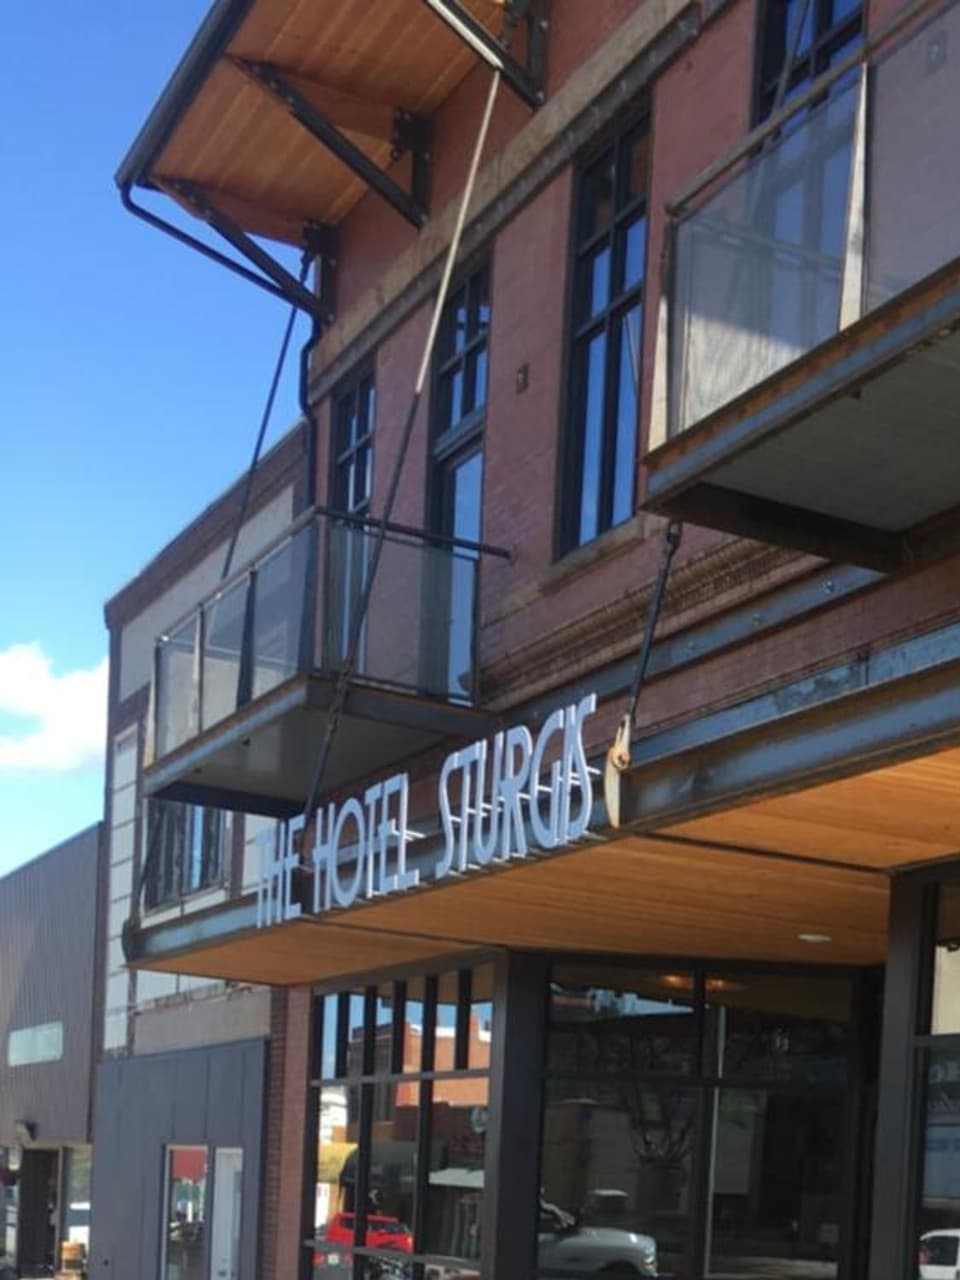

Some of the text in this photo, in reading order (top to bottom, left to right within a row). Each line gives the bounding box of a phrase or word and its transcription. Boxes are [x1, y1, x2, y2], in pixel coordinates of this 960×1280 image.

[255, 693, 597, 929] THE HOTEL STURGIS
